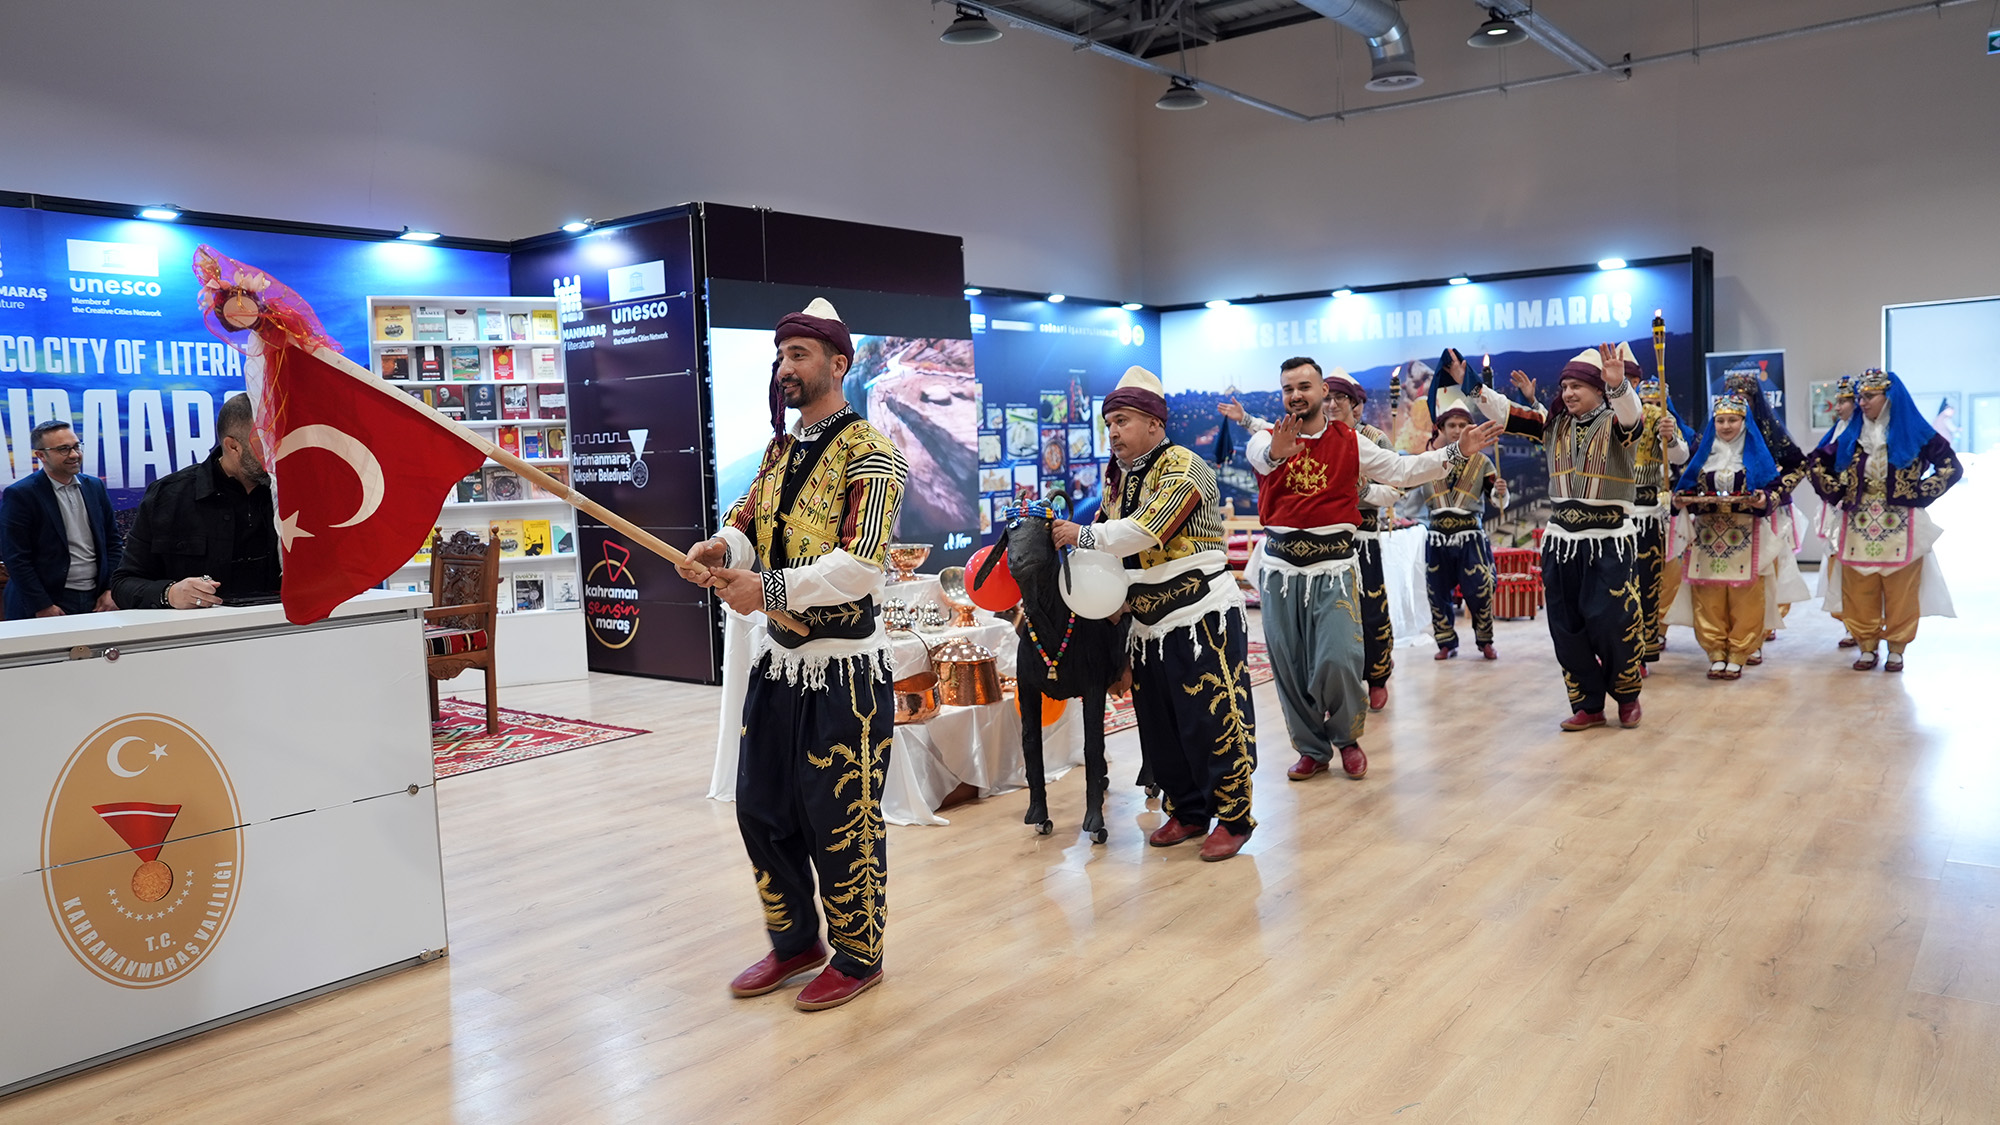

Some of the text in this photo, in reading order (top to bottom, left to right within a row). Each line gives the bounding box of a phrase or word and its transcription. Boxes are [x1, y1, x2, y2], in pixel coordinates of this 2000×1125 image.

[69, 277, 161, 297] unesco
[0, 298, 25, 310] ture
[71, 297, 103, 306] Member
[85, 307, 114, 315] Creative
[114, 308, 133, 316] Cities
[133, 309, 162, 317] Network
[611, 301, 668, 324] unesco
[43, 336, 107, 374] CITY
[115, 339, 146, 375] OF
[574, 468, 632, 485] ükşehir Belediyesi
[585, 584, 638, 600] kahraman
[596, 617, 630, 634] maraş
[62, 860, 233, 979] KAHRAMANMARAŞ VALİLİĞİ
[145, 932, 176, 952] T.C.
